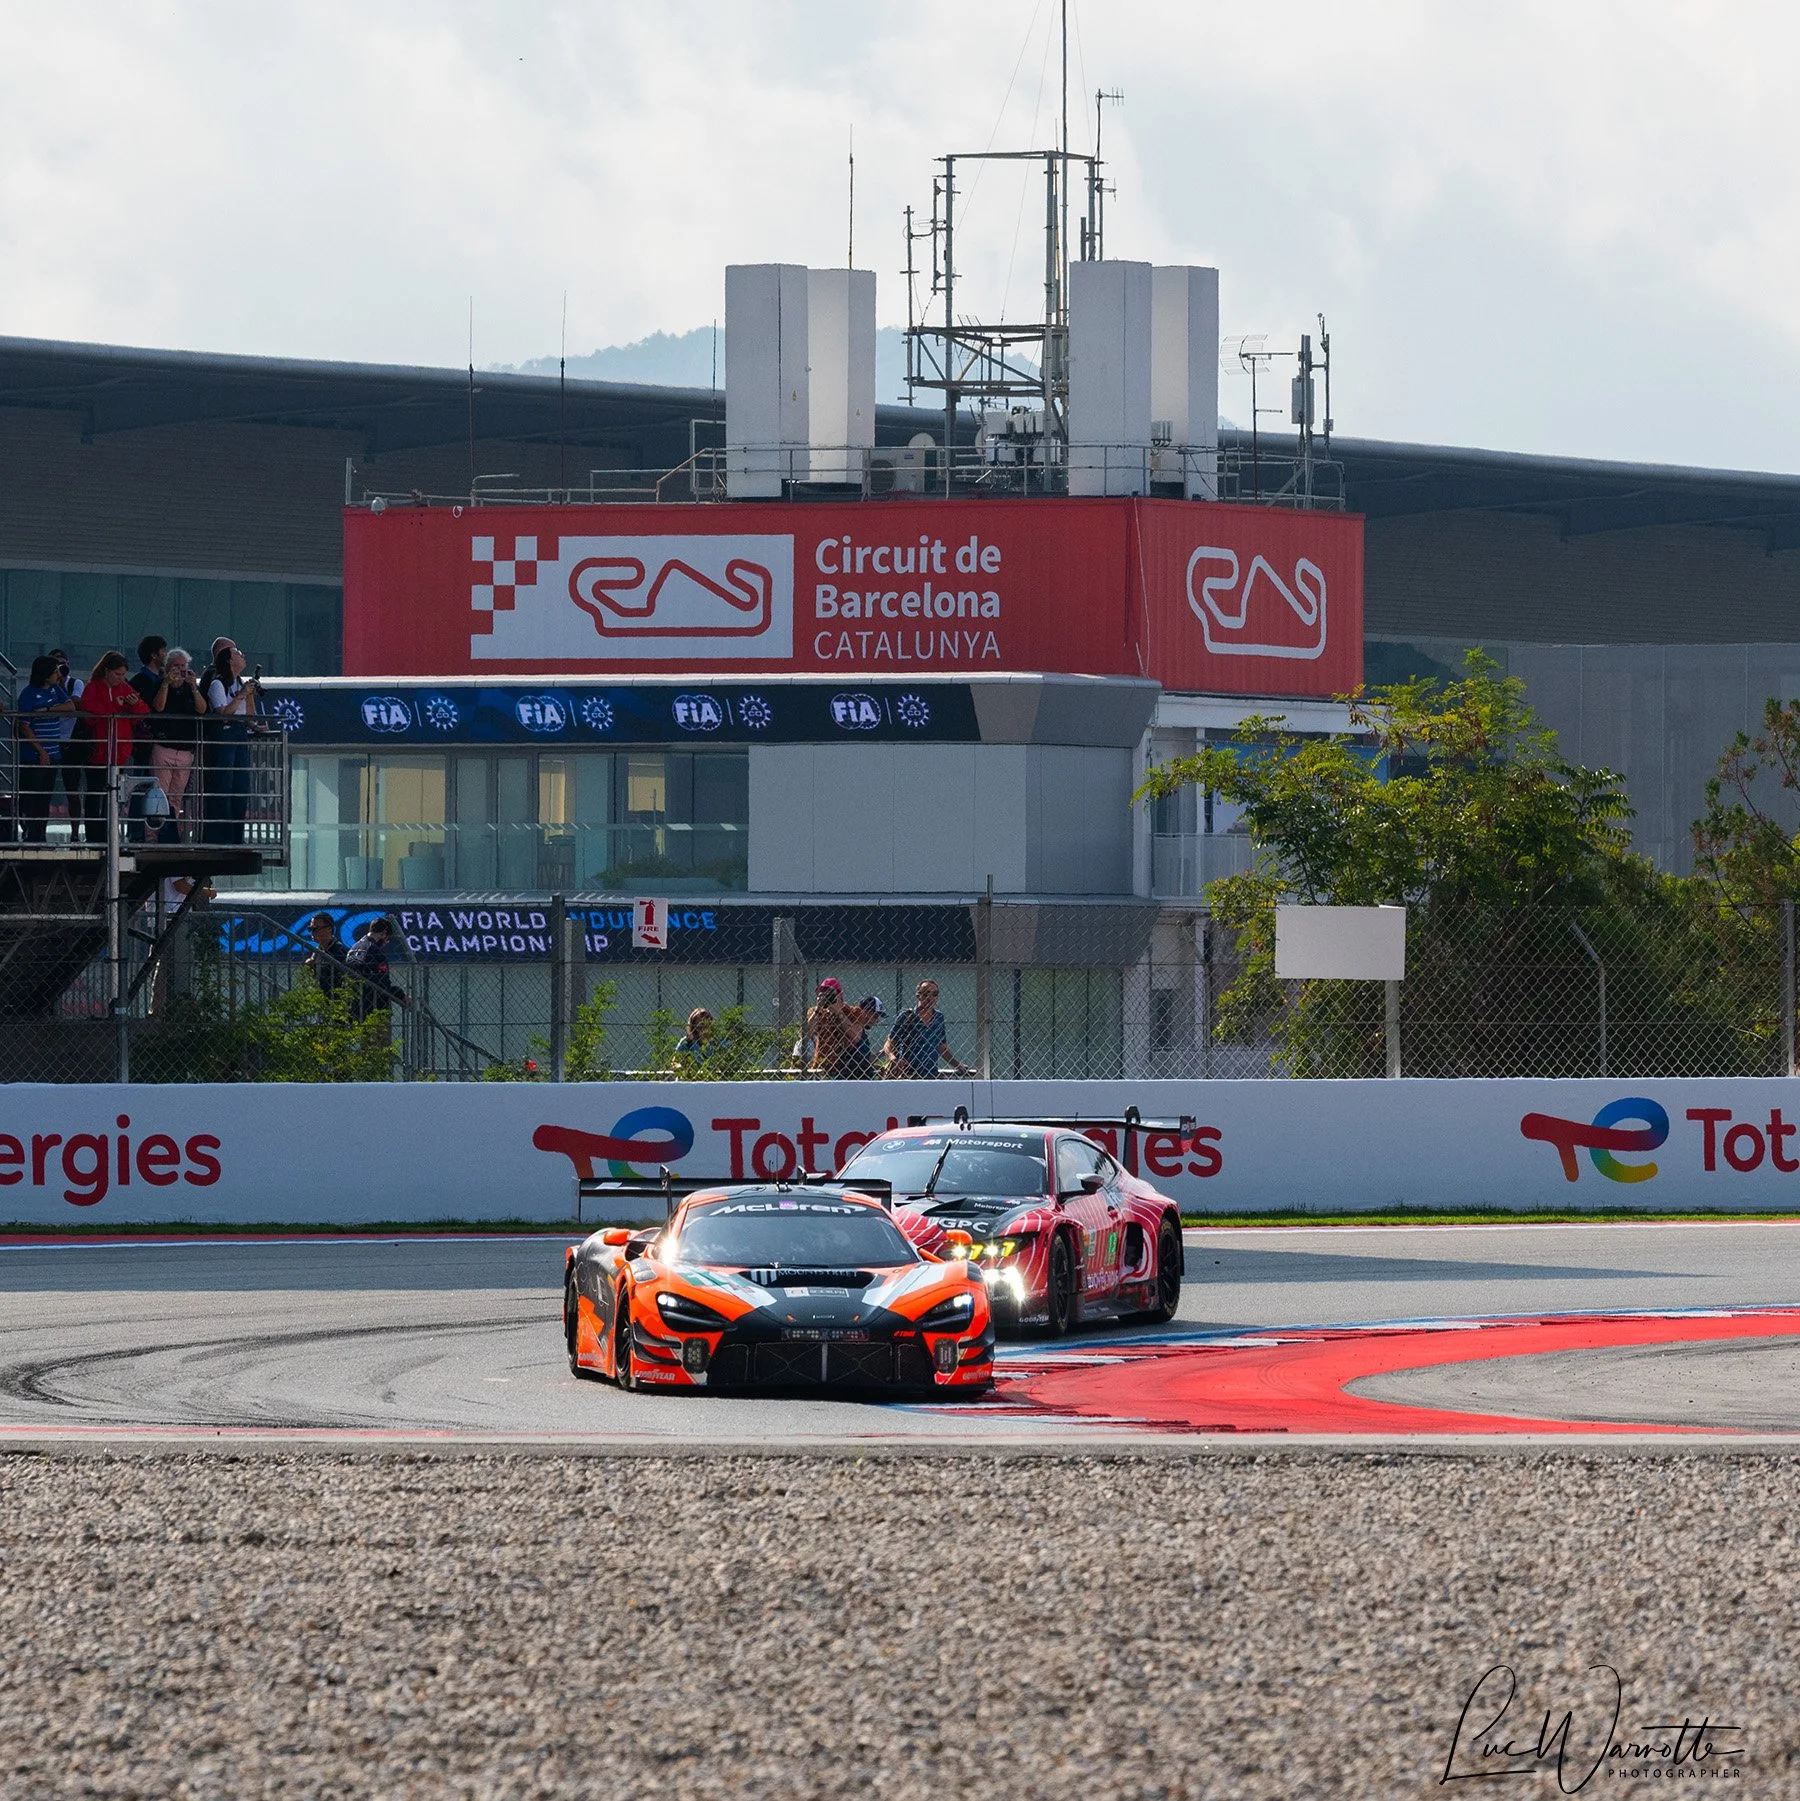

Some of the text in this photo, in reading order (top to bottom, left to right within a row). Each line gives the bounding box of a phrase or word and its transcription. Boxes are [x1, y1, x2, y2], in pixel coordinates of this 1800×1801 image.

[815, 534, 1001, 575] Circuit de
[815, 582, 1001, 619] Barcelona
[814, 630, 1001, 660] CATALUNYA
[401, 911, 444, 930] FIA
[449, 911, 547, 930] WORLD
[406, 934, 609, 953] CHAMPIONIP
[945, 1138, 1024, 1150] Motorsport
[1686, 1107, 1800, 1173] Tot
[708, 1203, 868, 1217] McLaren
